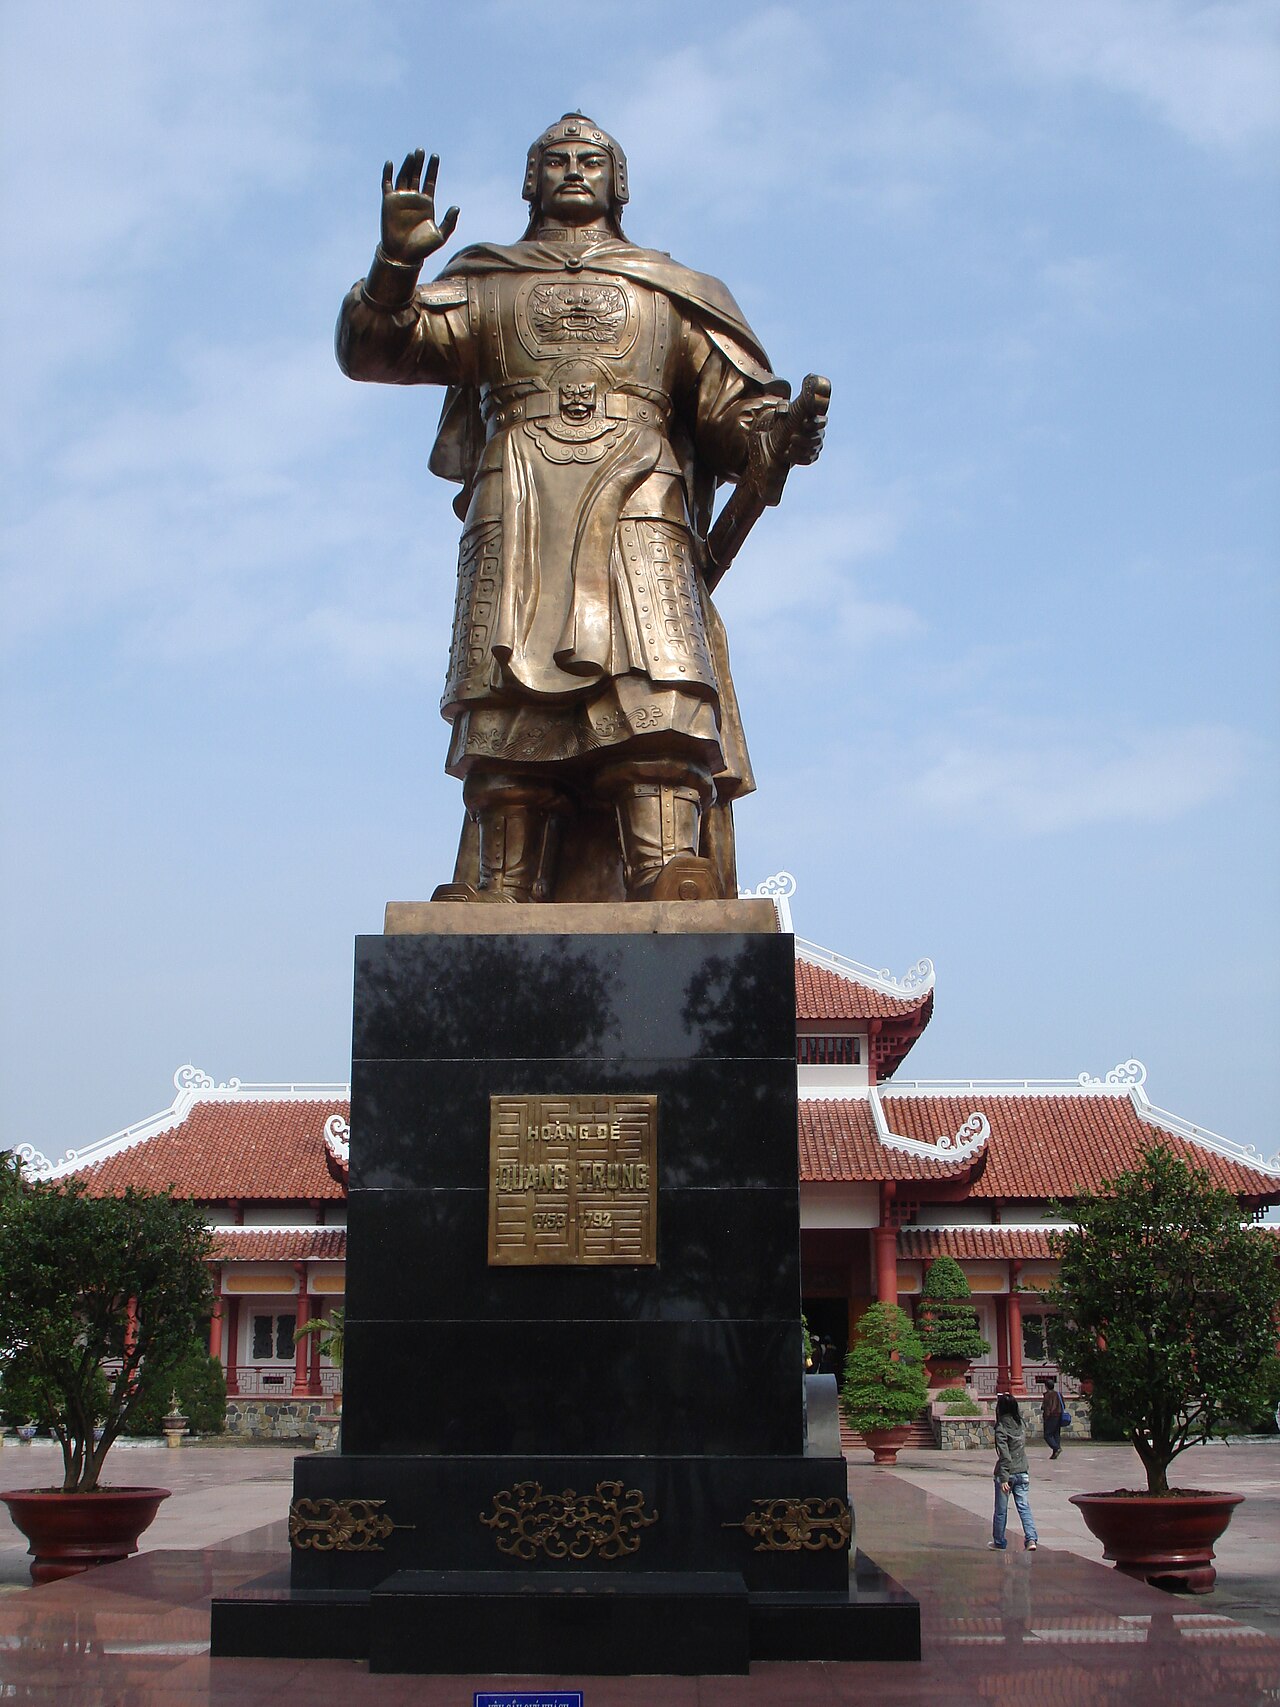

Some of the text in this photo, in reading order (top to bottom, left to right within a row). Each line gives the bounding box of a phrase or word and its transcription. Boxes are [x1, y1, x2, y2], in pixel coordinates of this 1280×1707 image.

[527, 1120, 589, 1141] HOÀNG
[498, 1164, 648, 1191] QUANG TRUNG
[533, 1213, 566, 1229] 1753
[579, 1213, 612, 1229] 1792
